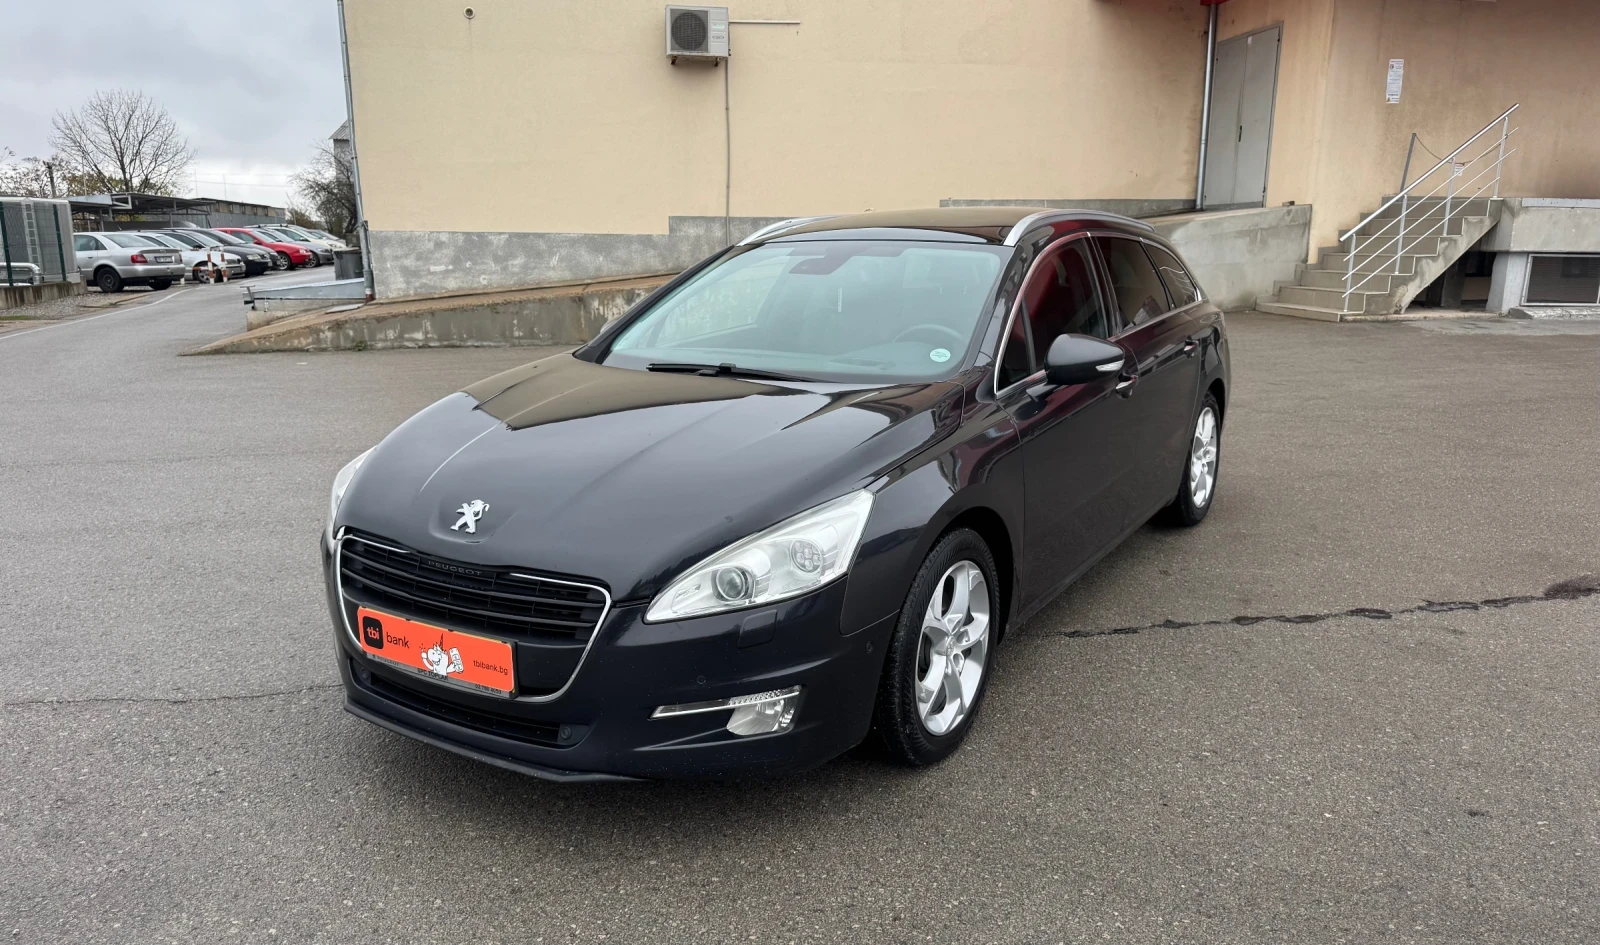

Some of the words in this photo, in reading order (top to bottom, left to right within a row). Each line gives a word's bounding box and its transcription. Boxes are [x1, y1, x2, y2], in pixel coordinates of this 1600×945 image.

[428, 560, 482, 576] PEUGEOT
[367, 626, 380, 640] tbi
[386, 632, 410, 649] bank
[473, 660, 508, 676] tbibank.bg
